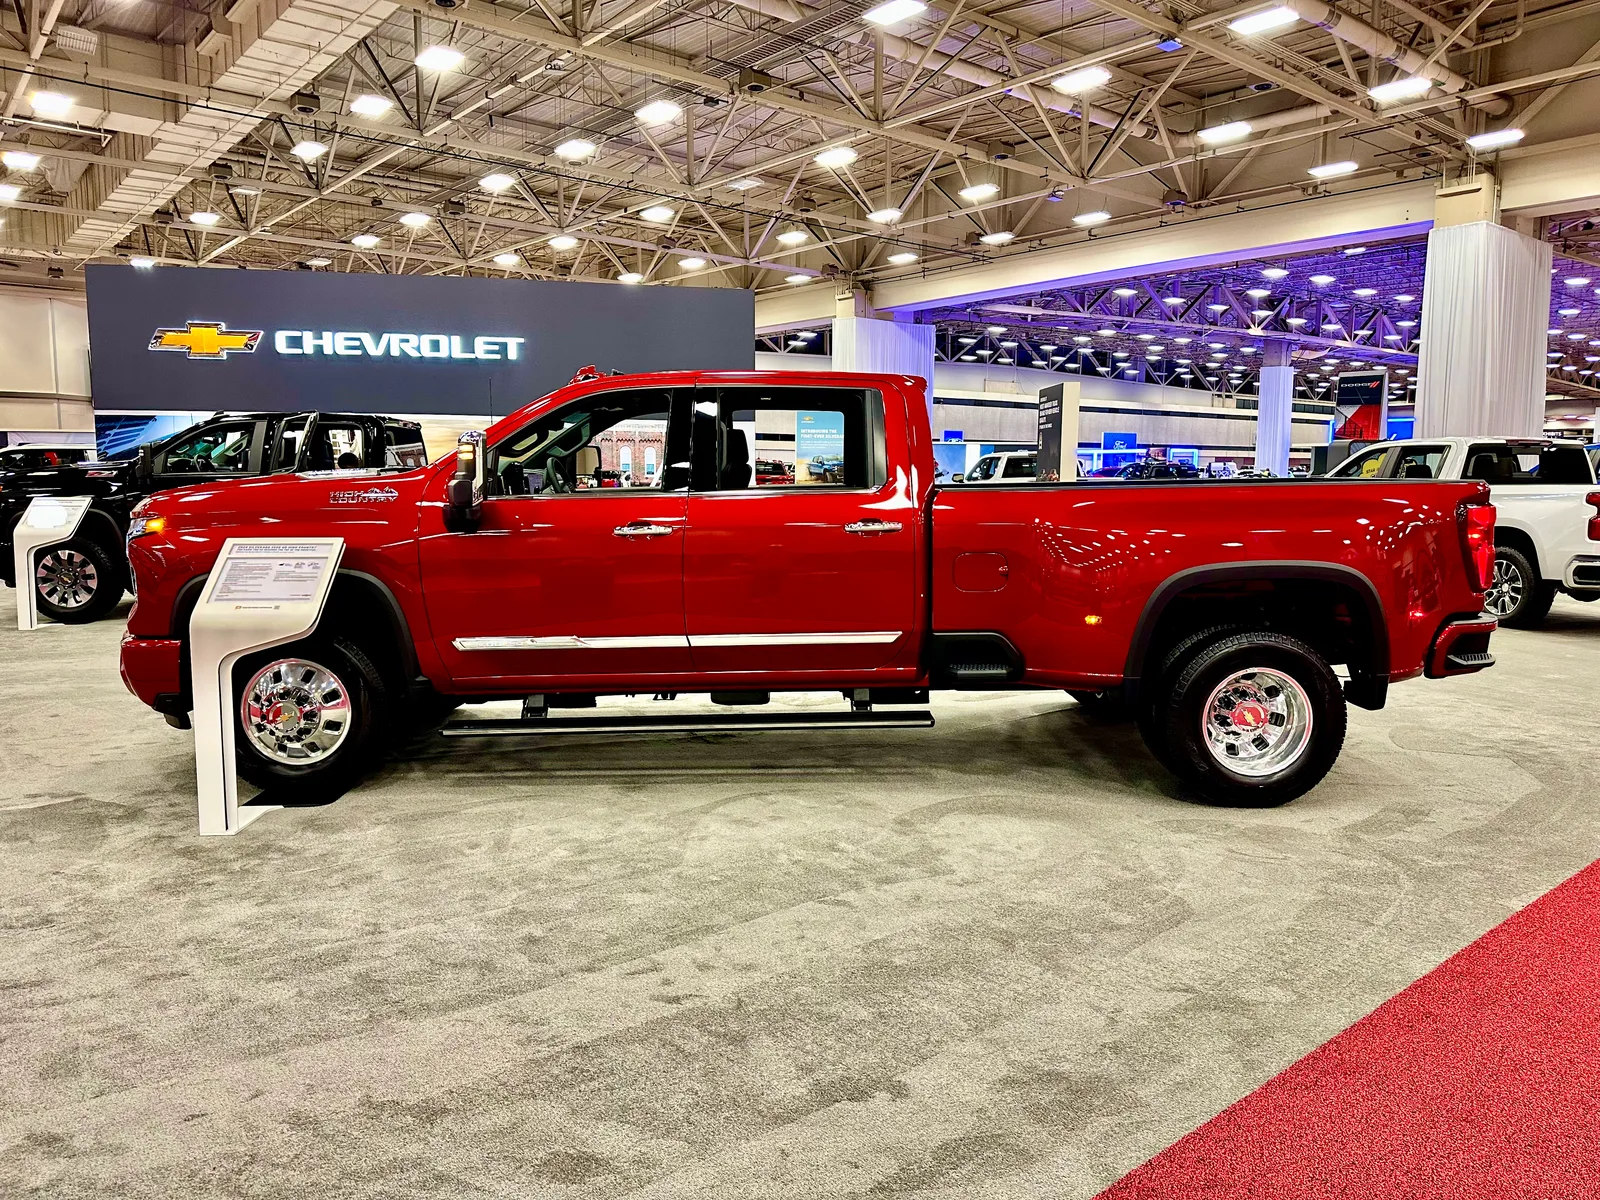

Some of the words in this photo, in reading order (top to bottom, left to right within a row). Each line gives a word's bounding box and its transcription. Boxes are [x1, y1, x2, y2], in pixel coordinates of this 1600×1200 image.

[274, 330, 525, 360] CHEVROLET
[1114, 440, 1127, 449] Ford
[329, 496, 398, 504] COUNTRY
